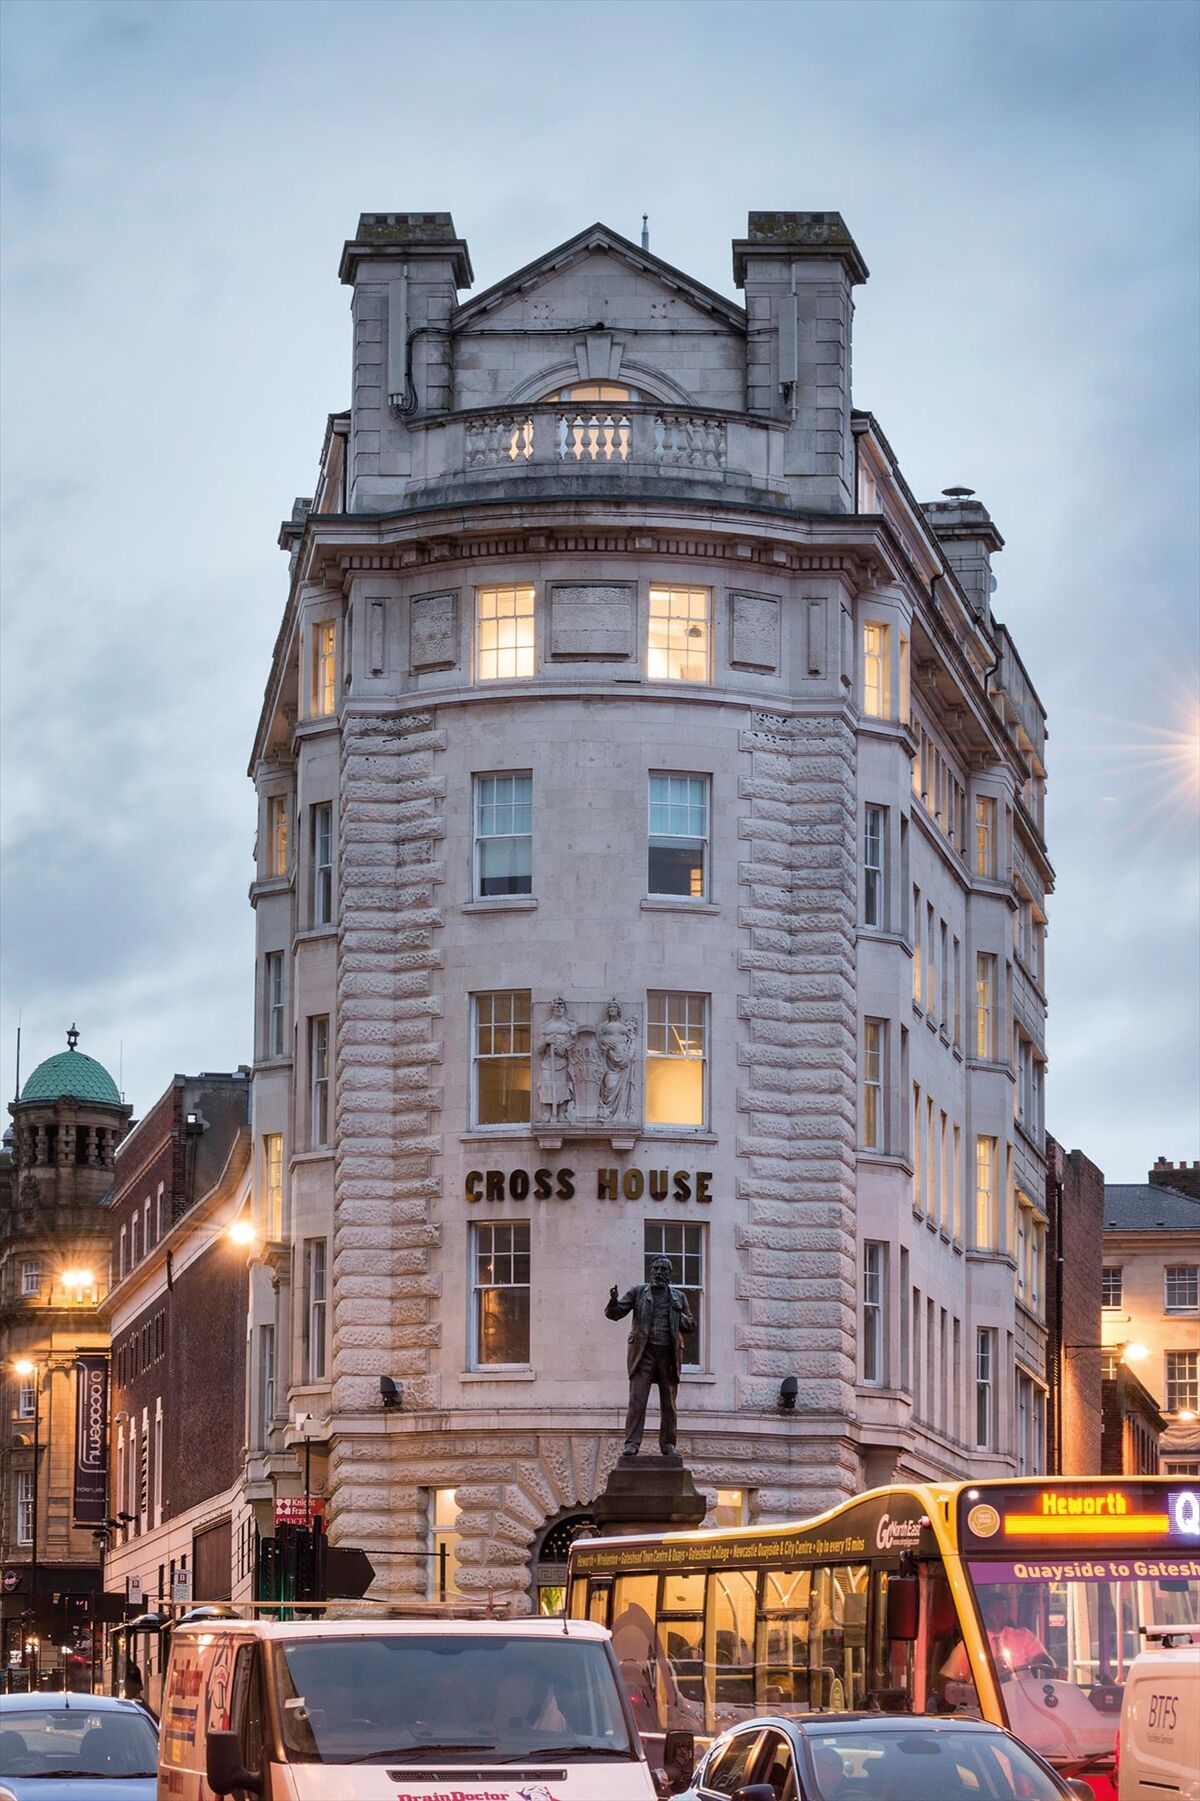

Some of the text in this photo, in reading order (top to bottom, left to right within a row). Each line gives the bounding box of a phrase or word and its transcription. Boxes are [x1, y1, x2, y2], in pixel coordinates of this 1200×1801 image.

[465, 1168, 713, 1203] CROSS HOUSE
[1042, 1493, 1126, 1514] Heworth
[689, 1546, 711, 1560] Gateshead
[733, 1544, 757, 1558] Newcastle
[758, 1542, 780, 1559] Quayside
[785, 1541, 795, 1558] City
[795, 1540, 812, 1554] Centre
[816, 1539, 822, 1556] Up
[823, 1540, 829, 1552] to
[829, 1540, 844, 1555] every
[851, 1536, 864, 1551] mins
[1014, 1561, 1105, 1580] Quayside
[1109, 1561, 1130, 1577] to
[1148, 1695, 1179, 1730] BTFS
